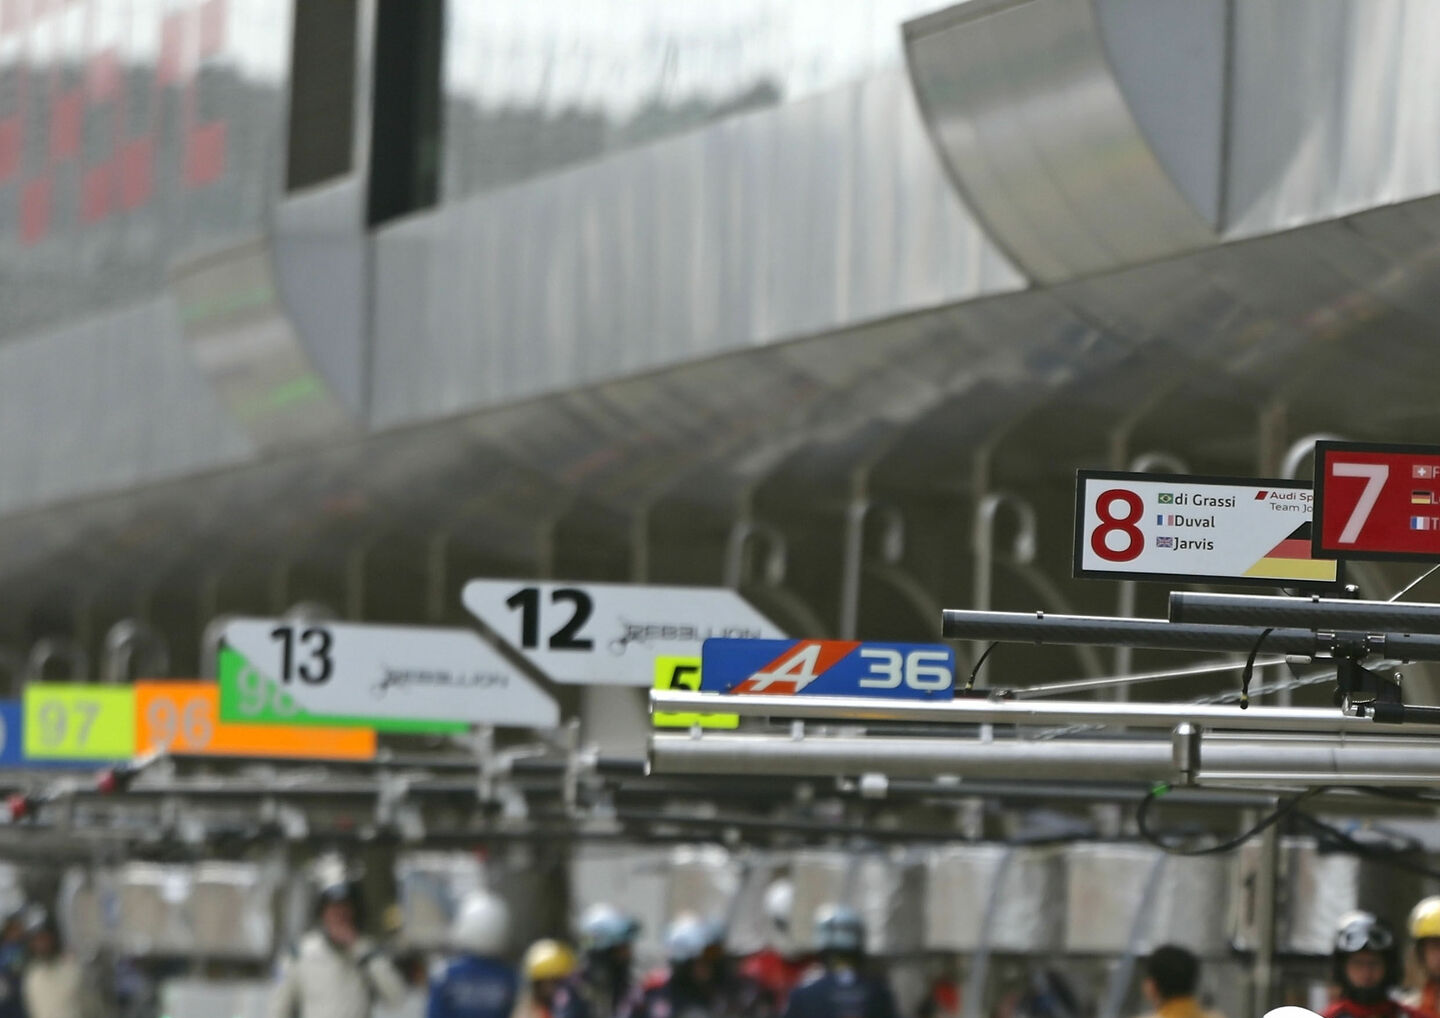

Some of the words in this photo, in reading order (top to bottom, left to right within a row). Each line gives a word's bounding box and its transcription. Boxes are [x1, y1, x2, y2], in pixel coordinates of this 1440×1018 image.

[1174, 493, 1188, 507] di
[1193, 493, 1236, 508] Grassi
[1270, 491, 1297, 500] Audi
[1270, 502, 1299, 512] Team
[1332, 463, 1389, 543] 7
[1091, 489, 1145, 562] 8
[1173, 537, 1214, 551] Jarvis
[1174, 515, 1216, 529] Duval
[506, 587, 595, 651] 12
[270, 626, 333, 684] 13
[859, 649, 952, 691] 36
[38, 697, 103, 749] 97
[146, 696, 214, 749] 96
